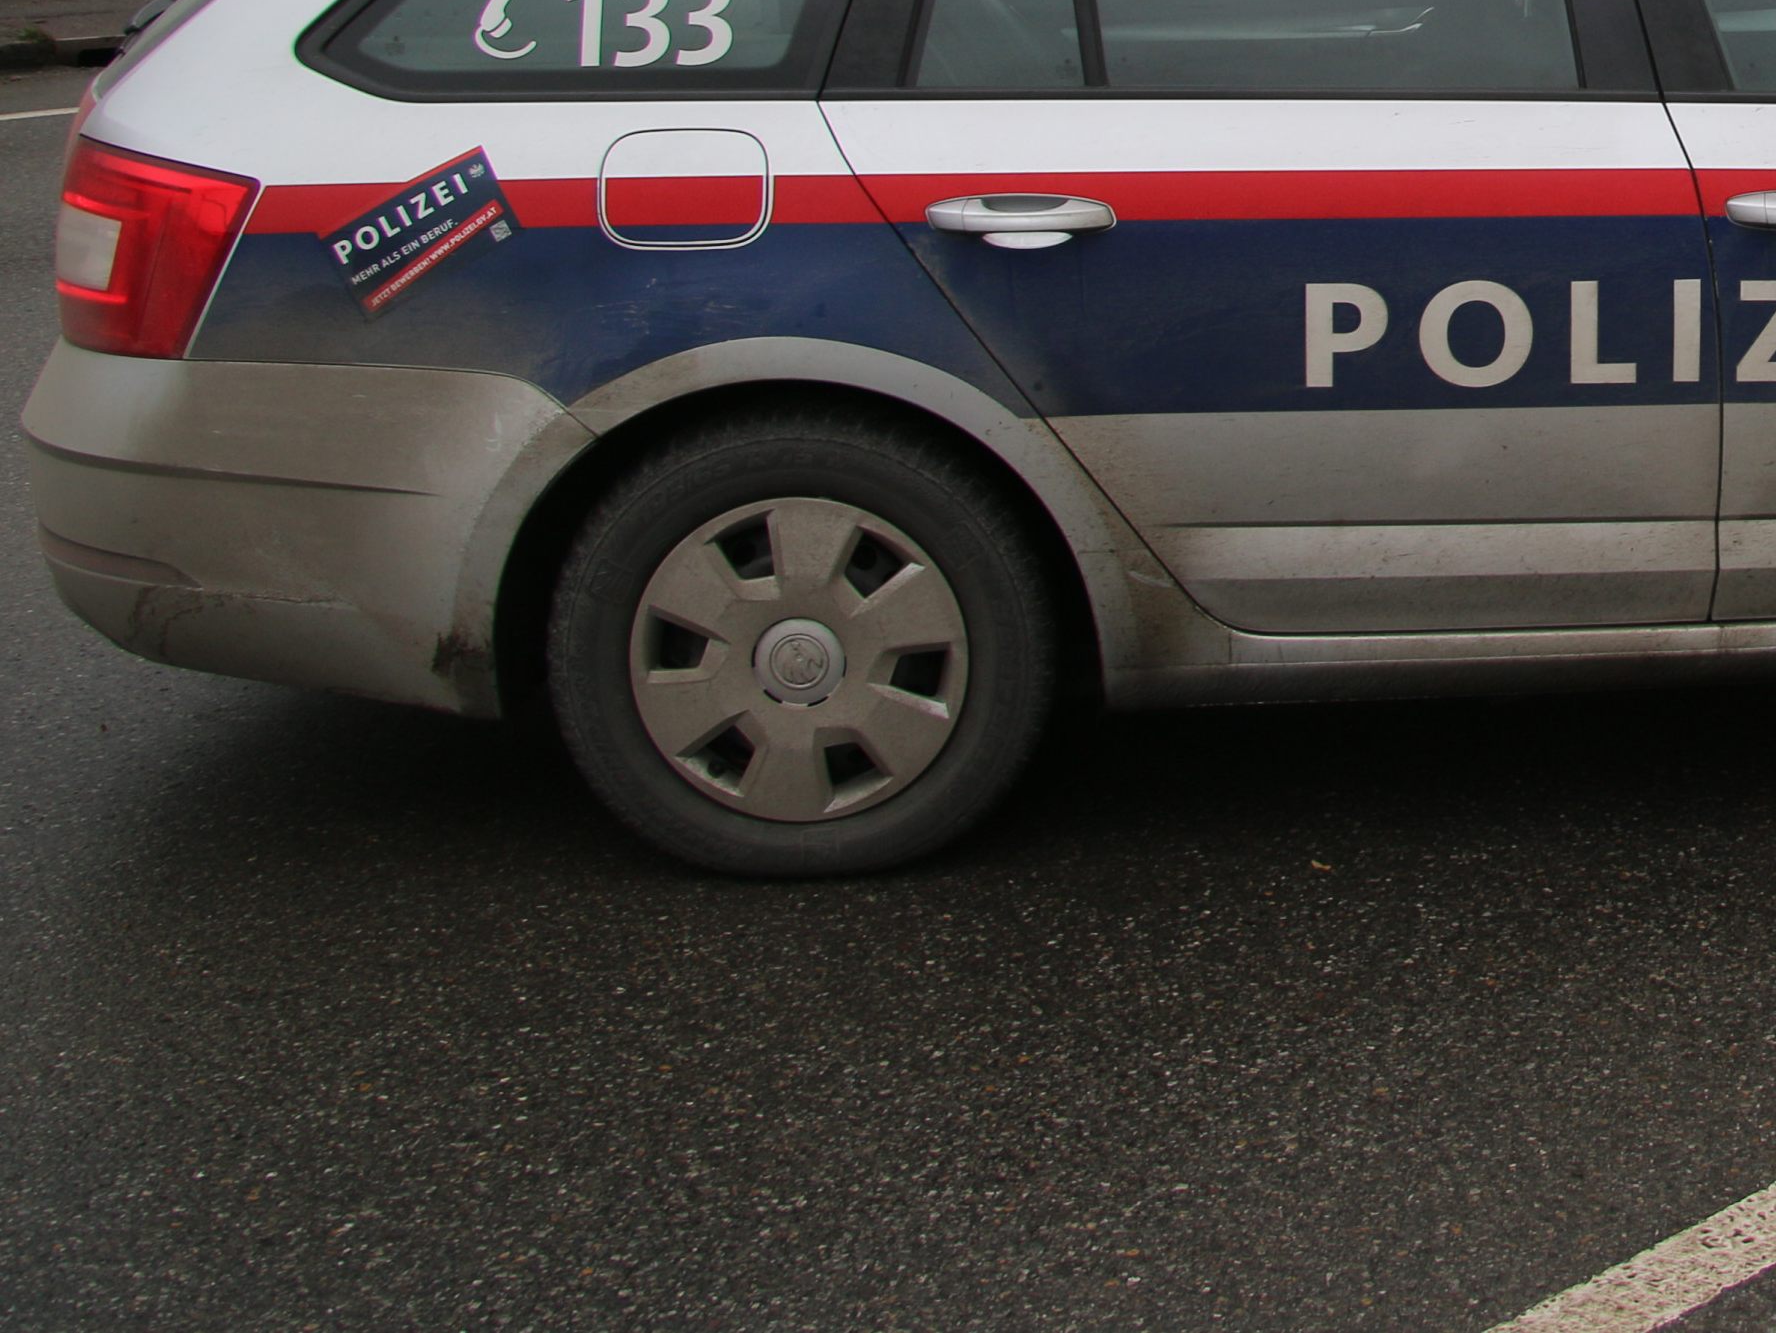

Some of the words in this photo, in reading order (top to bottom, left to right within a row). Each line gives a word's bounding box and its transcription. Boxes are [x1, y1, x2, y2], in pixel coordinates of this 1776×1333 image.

[333, 173, 469, 265] POLIZEI
[351, 263, 381, 285] MEHR
[381, 250, 402, 268] ALS
[401, 239, 421, 256] EIN
[420, 219, 459, 244] BERUF.
